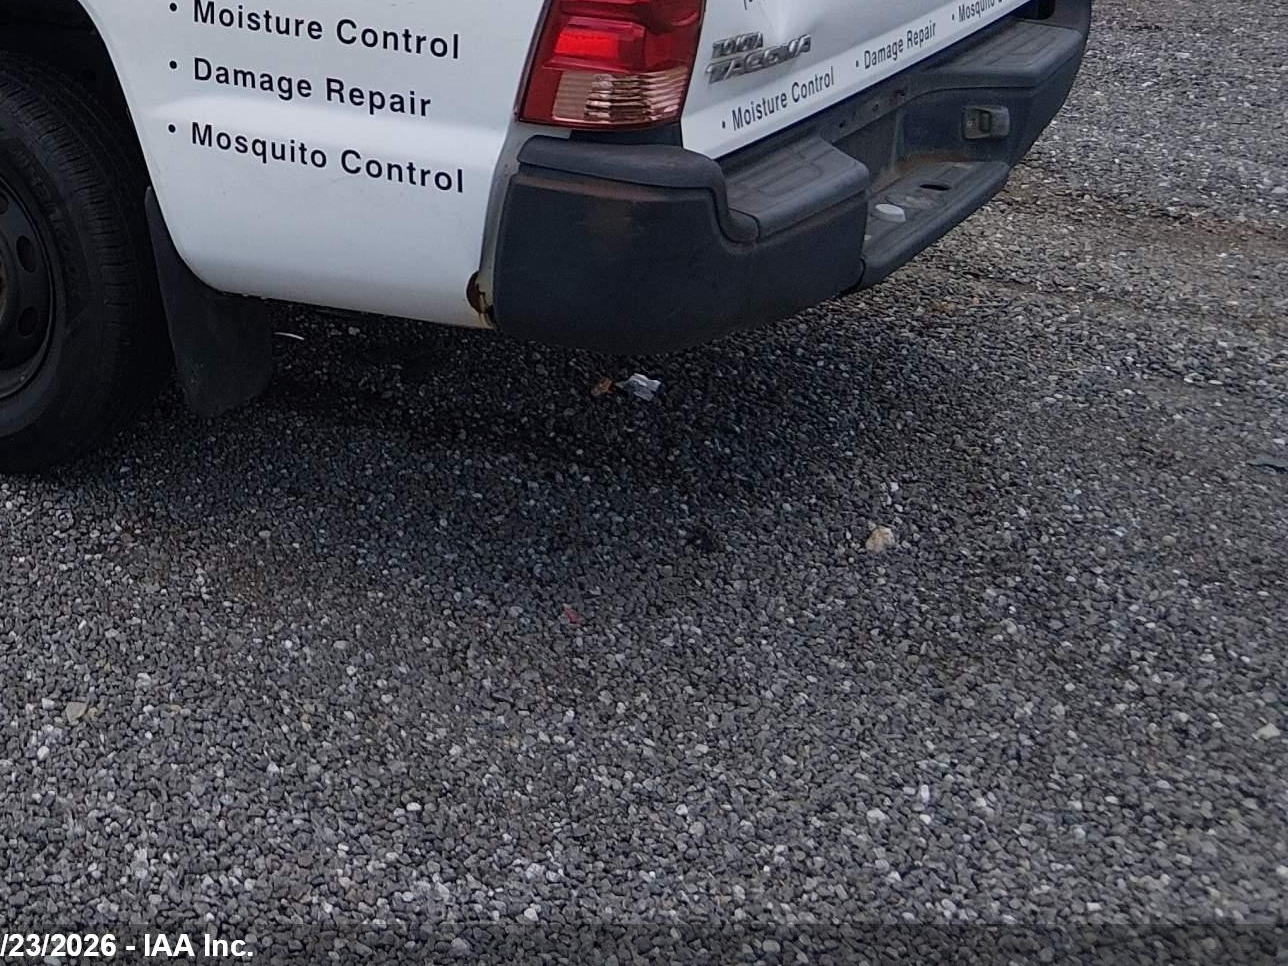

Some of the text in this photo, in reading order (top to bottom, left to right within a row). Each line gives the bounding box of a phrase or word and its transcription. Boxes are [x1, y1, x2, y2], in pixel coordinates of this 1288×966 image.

[193, 0, 459, 59] Moisture Control
[864, 20, 937, 69] Damage Repair
[194, 57, 431, 117] Damage Repair
[732, 66, 834, 130] Moisture Control
[192, 122, 463, 193] Mosquito Control
